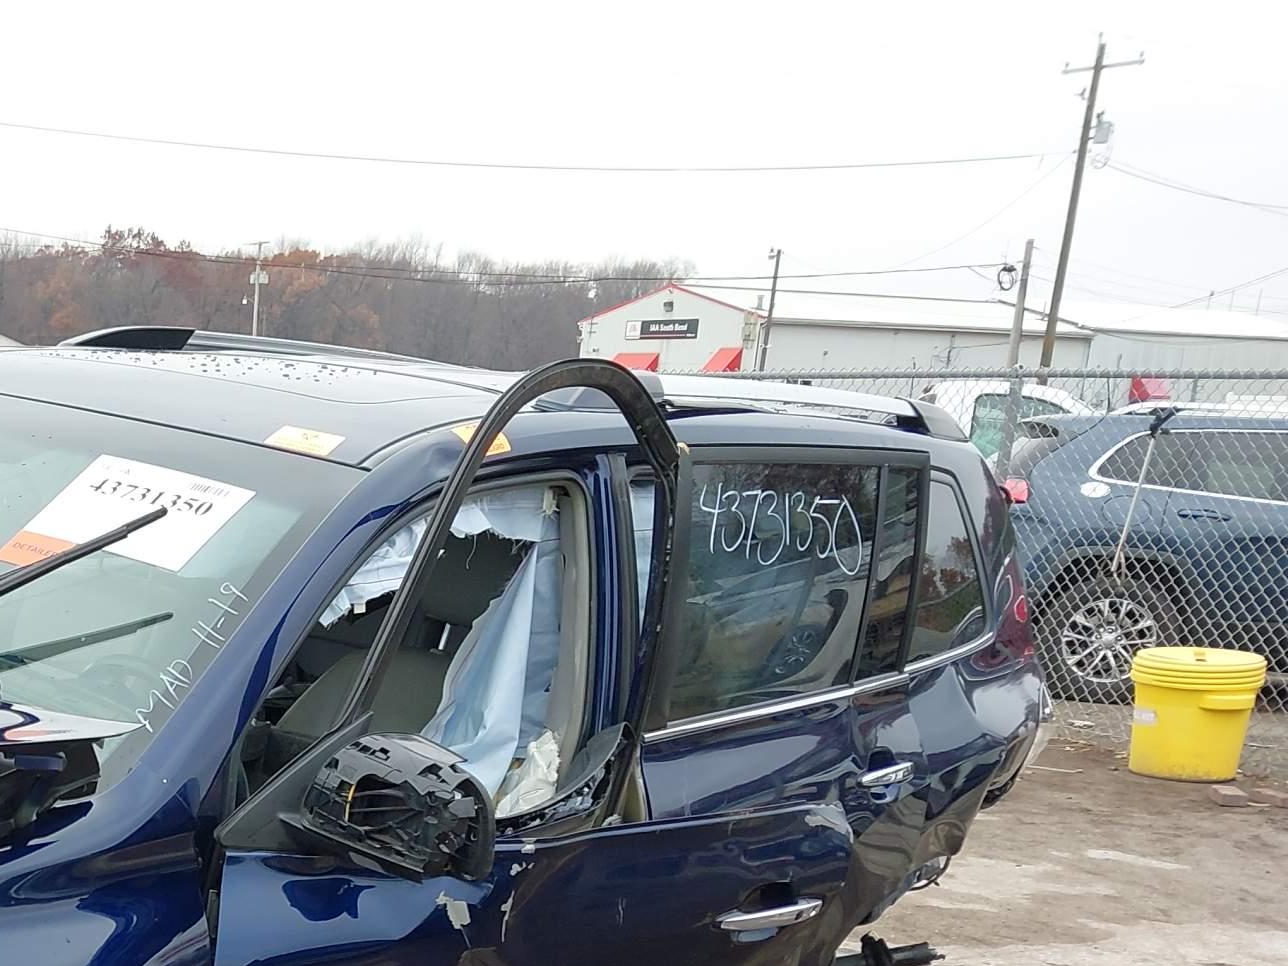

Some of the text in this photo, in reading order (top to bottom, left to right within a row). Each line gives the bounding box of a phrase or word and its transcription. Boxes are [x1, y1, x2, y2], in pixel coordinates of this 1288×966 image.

[89, 478, 214, 516] 43731350
[699, 482, 863, 576] 43731350
[191, 582, 249, 649] 11-19
